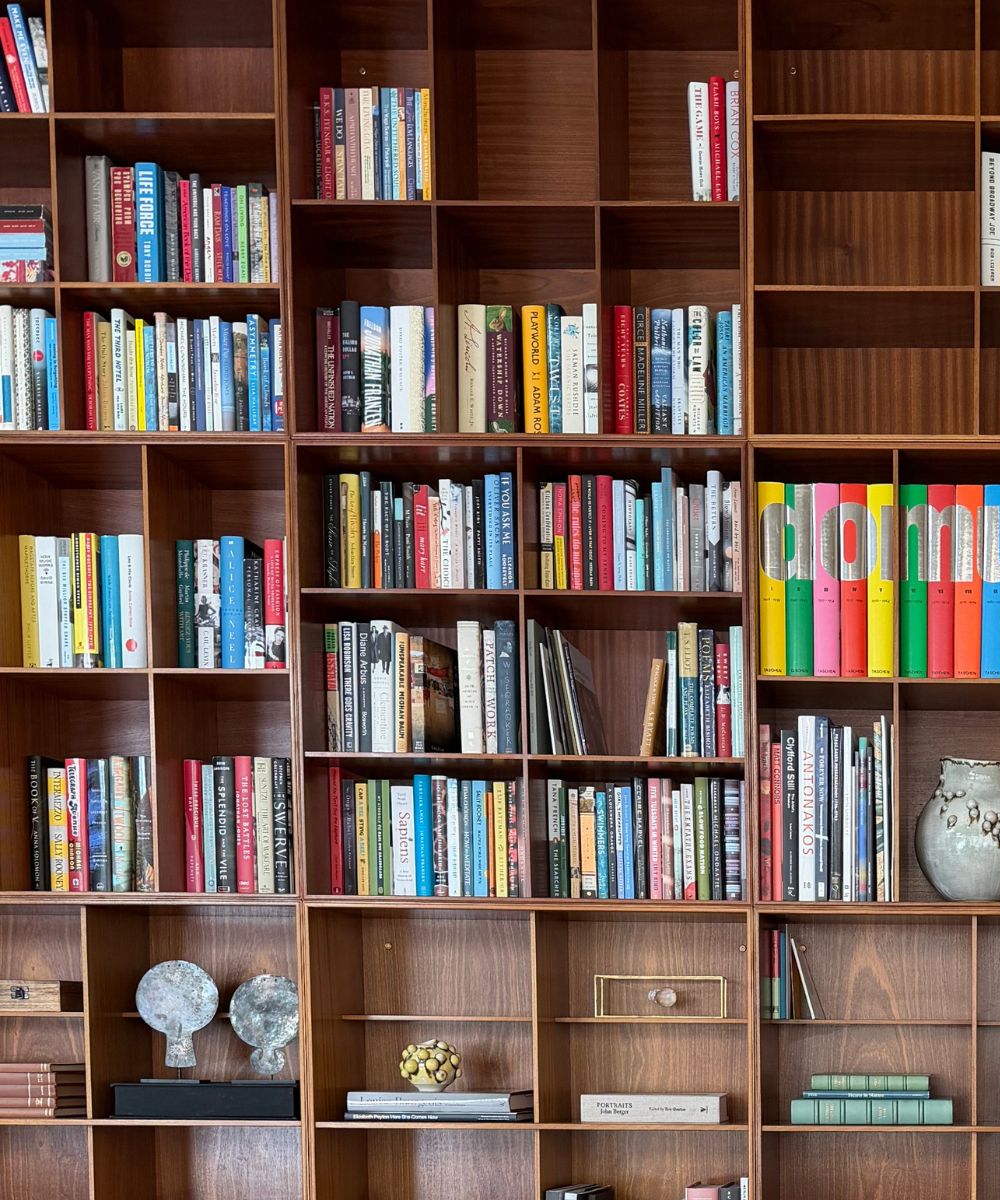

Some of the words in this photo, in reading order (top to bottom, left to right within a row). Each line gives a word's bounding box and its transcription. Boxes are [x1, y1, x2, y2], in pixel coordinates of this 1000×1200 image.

[11, 7, 21, 29] MAKE
[16, 30, 25, 41] ME
[730, 90, 739, 126] BRIAN
[731, 130, 740, 159] COX
[139, 170, 154, 195] LIFE
[139, 197, 155, 236] FORCE
[530, 311, 540, 365] PLAYWORLD
[636, 313, 645, 341] CIRCE
[249, 320, 258, 377] ASYMMETRY
[364, 330, 382, 381] JONATHAN
[636, 347, 646, 395] MADELINE
[364, 384, 382, 428] FRANZEN
[533, 386, 542, 414] ADAM
[637, 398, 646, 431] MILLER
[501, 477, 510, 486] IF
[501, 488, 510, 509] YOU
[415, 504, 427, 516] lit
[501, 511, 510, 529] ASK
[418, 536, 427, 556] mary
[502, 532, 511, 545] ME
[228, 549, 236, 607] ALICE
[420, 557, 428, 574] karr
[228, 619, 236, 666] NEEL
[360, 633, 369, 657] Diane
[701, 637, 711, 682] POEMS
[360, 660, 369, 685] Arbus
[486, 643, 495, 684] PATCH
[487, 699, 496, 740] WORK
[786, 737, 796, 772] Clyfford
[53, 771, 62, 822] INTERMEZZO
[786, 774, 796, 790] Still
[218, 785, 227, 837] SPLENDID
[242, 796, 250, 819] LOST
[802, 750, 814, 856] ANTONAKOS
[54, 833, 63, 858] SALLY
[243, 821, 251, 861] BATTLES
[274, 801, 288, 870] SWERVE
[397, 812, 412, 864] Sapiens
[55, 858, 64, 891] ROONEY
[219, 858, 228, 881] VILE
